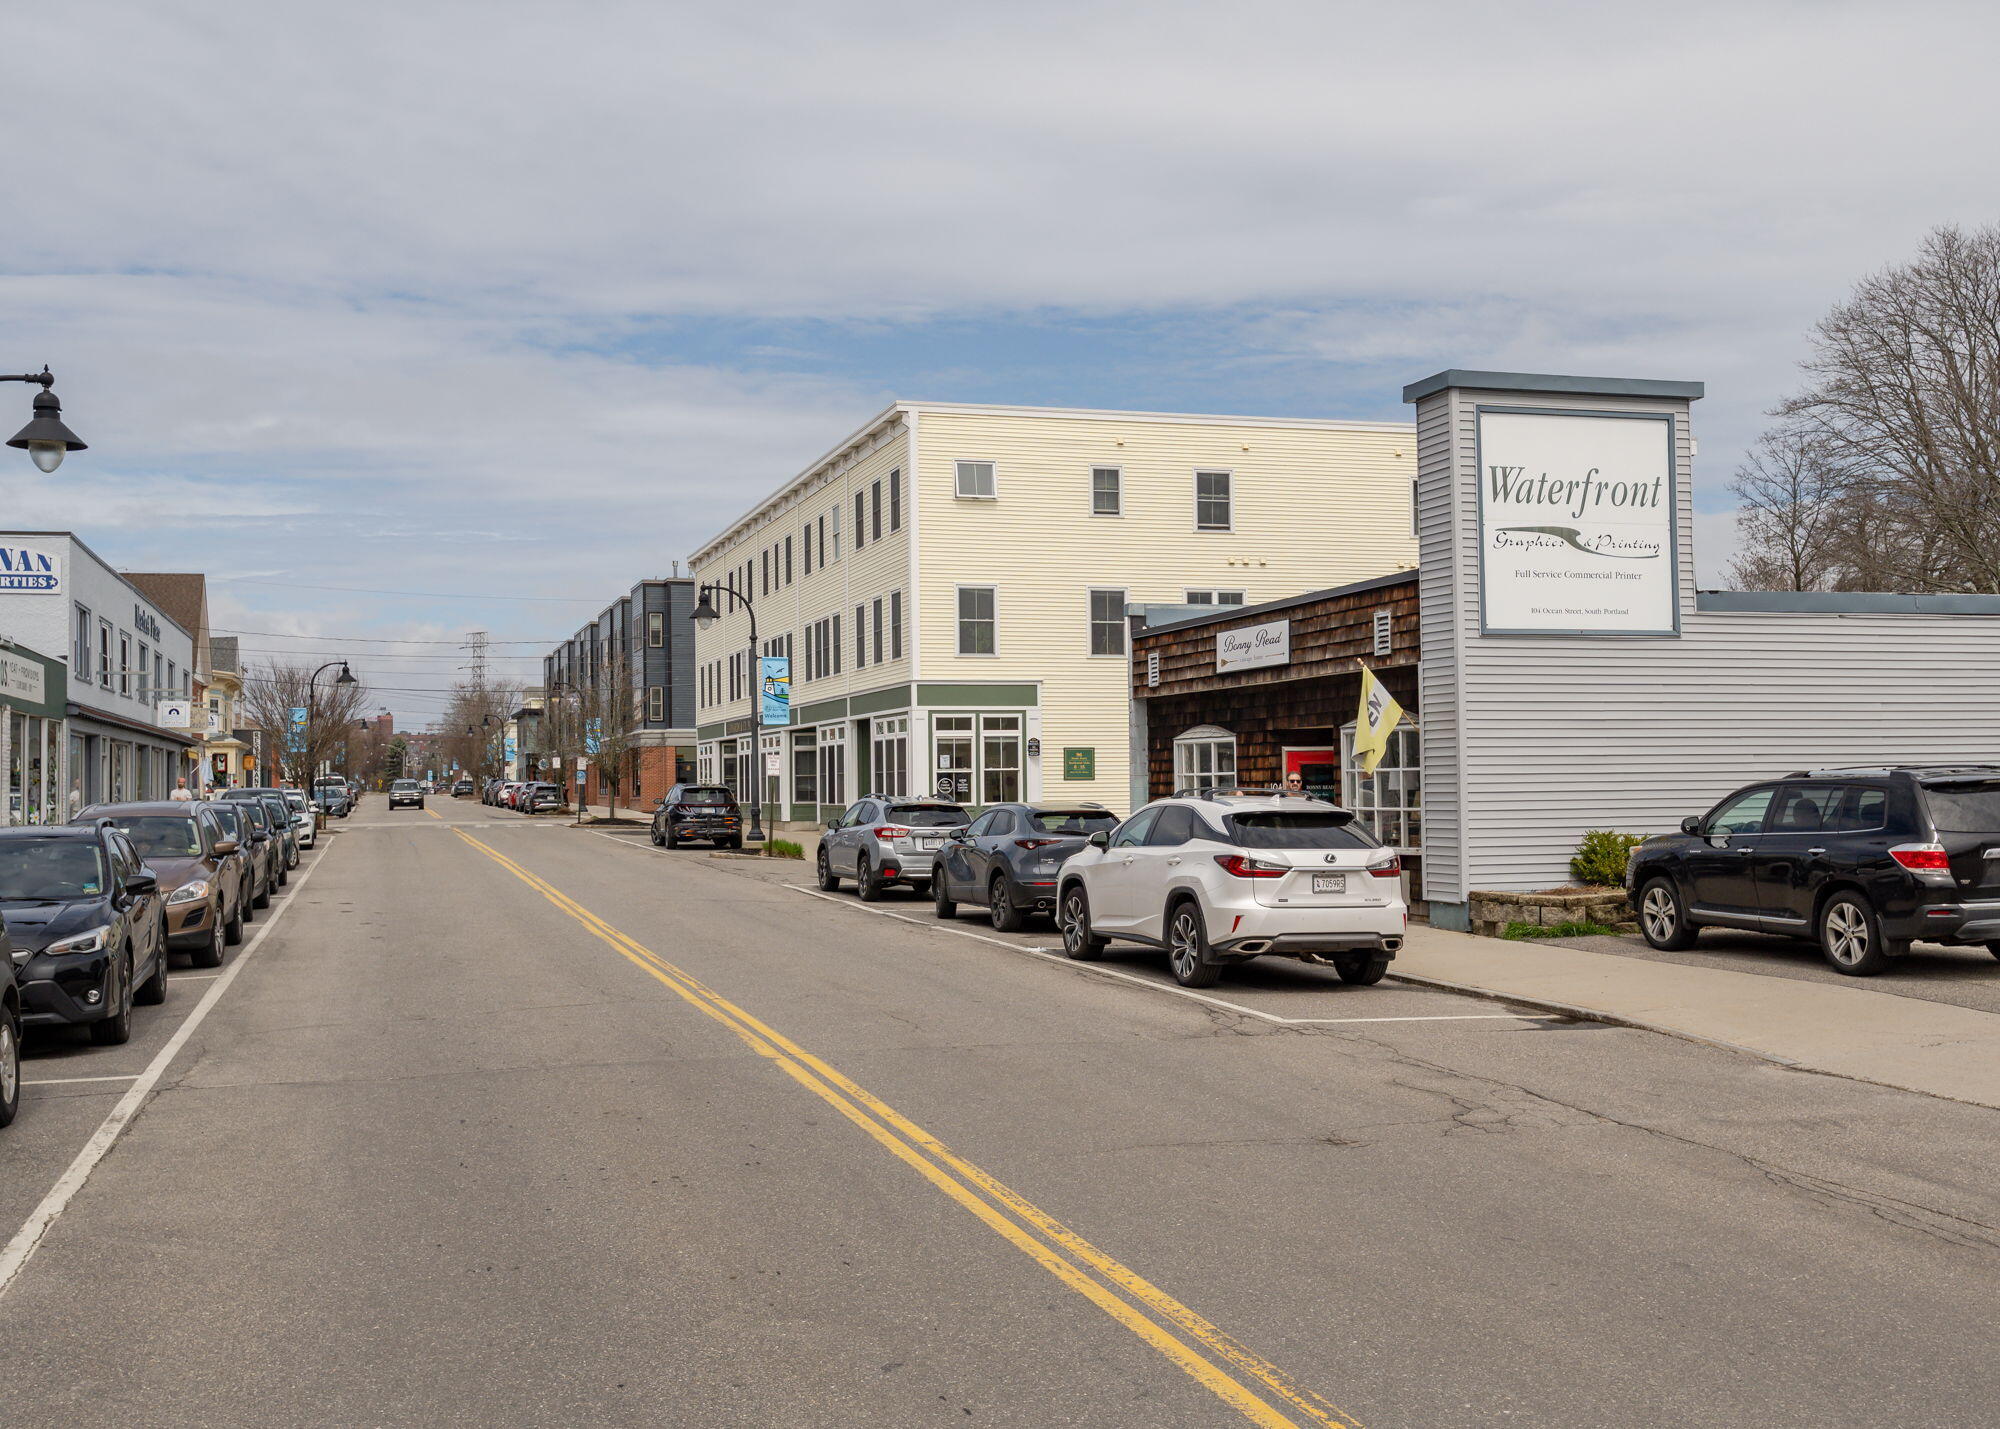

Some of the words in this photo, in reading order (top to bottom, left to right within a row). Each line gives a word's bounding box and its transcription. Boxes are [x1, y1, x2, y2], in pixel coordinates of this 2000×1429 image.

[1488, 465, 1663, 519] Waterfront
[1493, 531, 1565, 551] Graphics
[1595, 534, 1660, 554] Printing
[1515, 569, 1531, 578] Full
[1532, 569, 1562, 579] Service
[1564, 570, 1612, 579] Commercial
[1615, 571, 1642, 580] Printer
[1224, 634, 1252, 654] Bonny
[1255, 629, 1283, 648] Read
